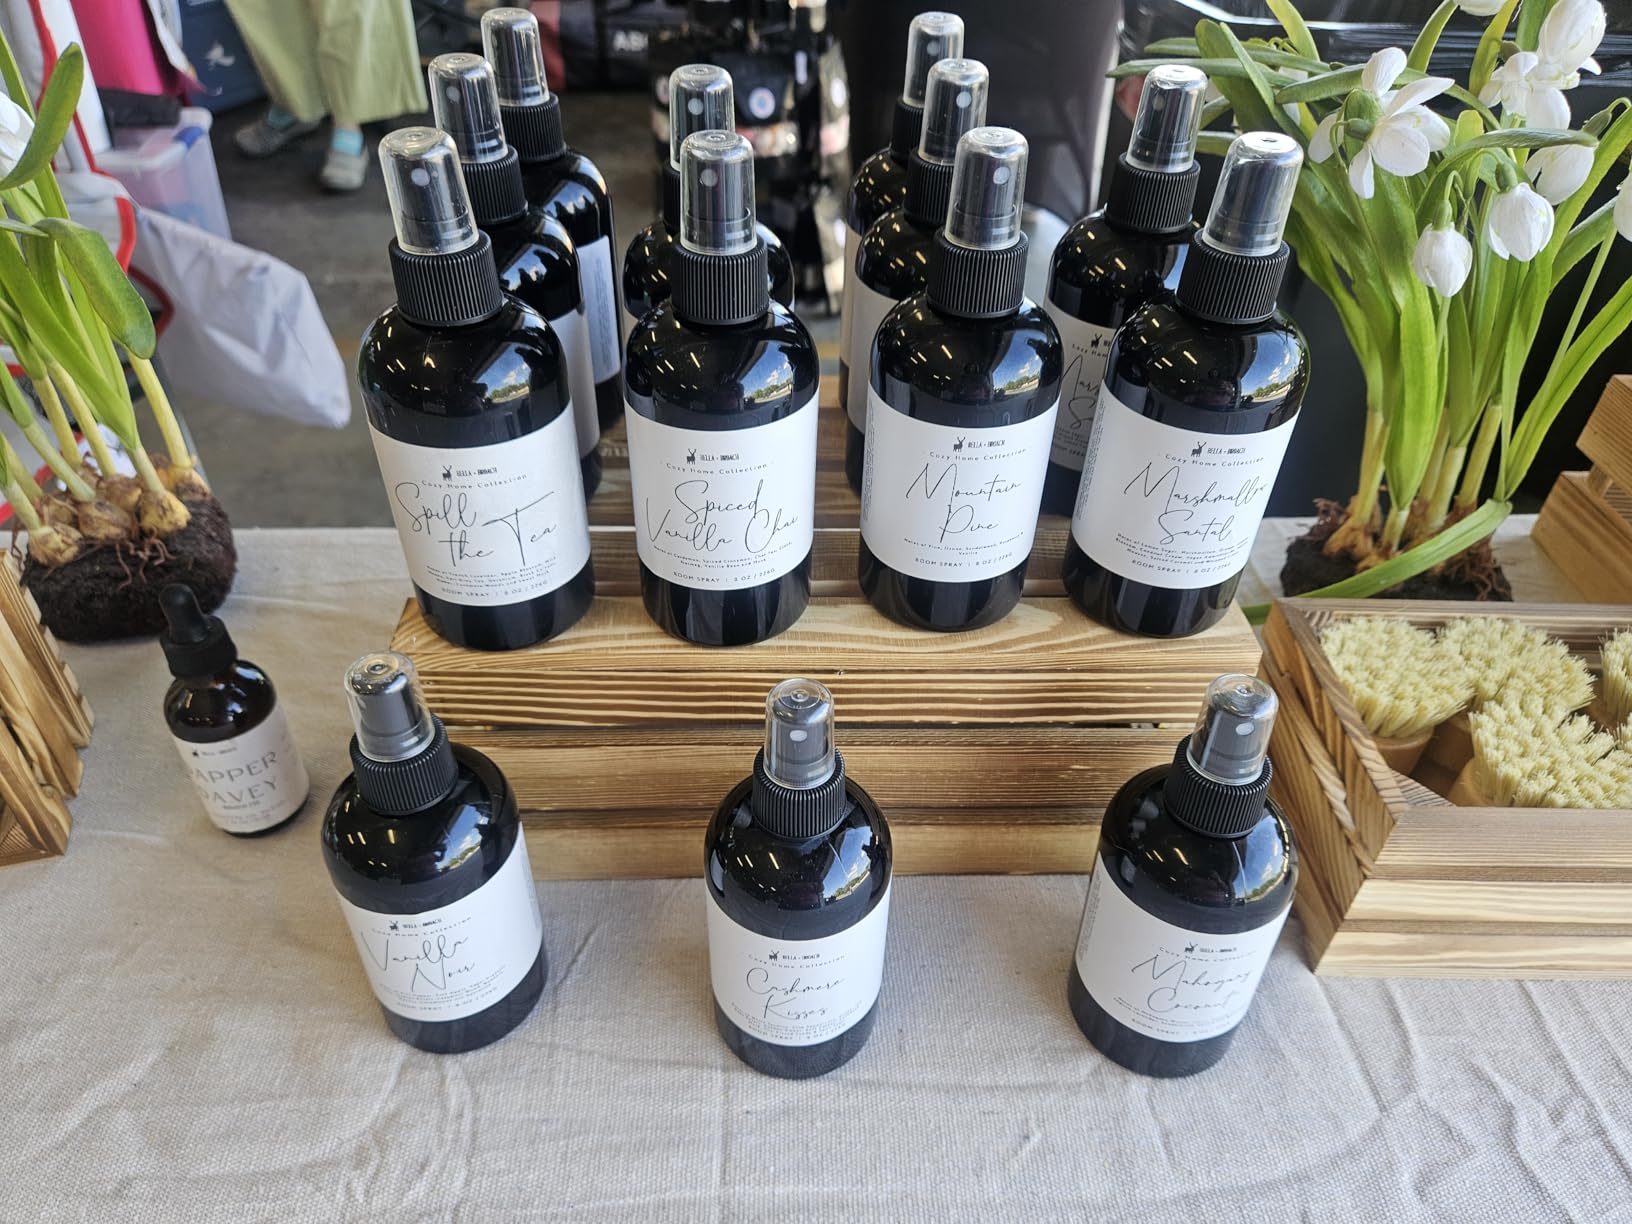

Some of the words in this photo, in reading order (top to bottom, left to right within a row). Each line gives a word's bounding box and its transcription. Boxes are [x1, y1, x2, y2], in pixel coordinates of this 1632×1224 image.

[666, 463, 686, 473] Cozy
[719, 464, 767, 474] Collection
[930, 451, 950, 461] Cozy
[983, 448, 1027, 461] Collection
[1165, 453, 1188, 464] Cozy
[1192, 459, 1217, 467] Home
[1221, 457, 1264, 467] Collection
[422, 480, 442, 489] Cozy
[477, 474, 527, 488] Collection
[906, 463, 1021, 505] Mountain
[675, 479, 763, 525] Spiced
[396, 482, 477, 535] Spill
[482, 491, 557, 566] Tea
[646, 497, 733, 551] Vanilla
[745, 508, 798, 553] Chai
[939, 505, 999, 543] Pine
[1158, 509, 1235, 545] Santal
[438, 529, 494, 567] the
[1132, 559, 1154, 568] ROOM
[673, 571, 694, 580] ROOM
[361, 931, 469, 971] Vanilla
[747, 968, 846, 996] Cashmere
[1131, 954, 1250, 993] Mahogany
[763, 994, 828, 1020] Kisses
